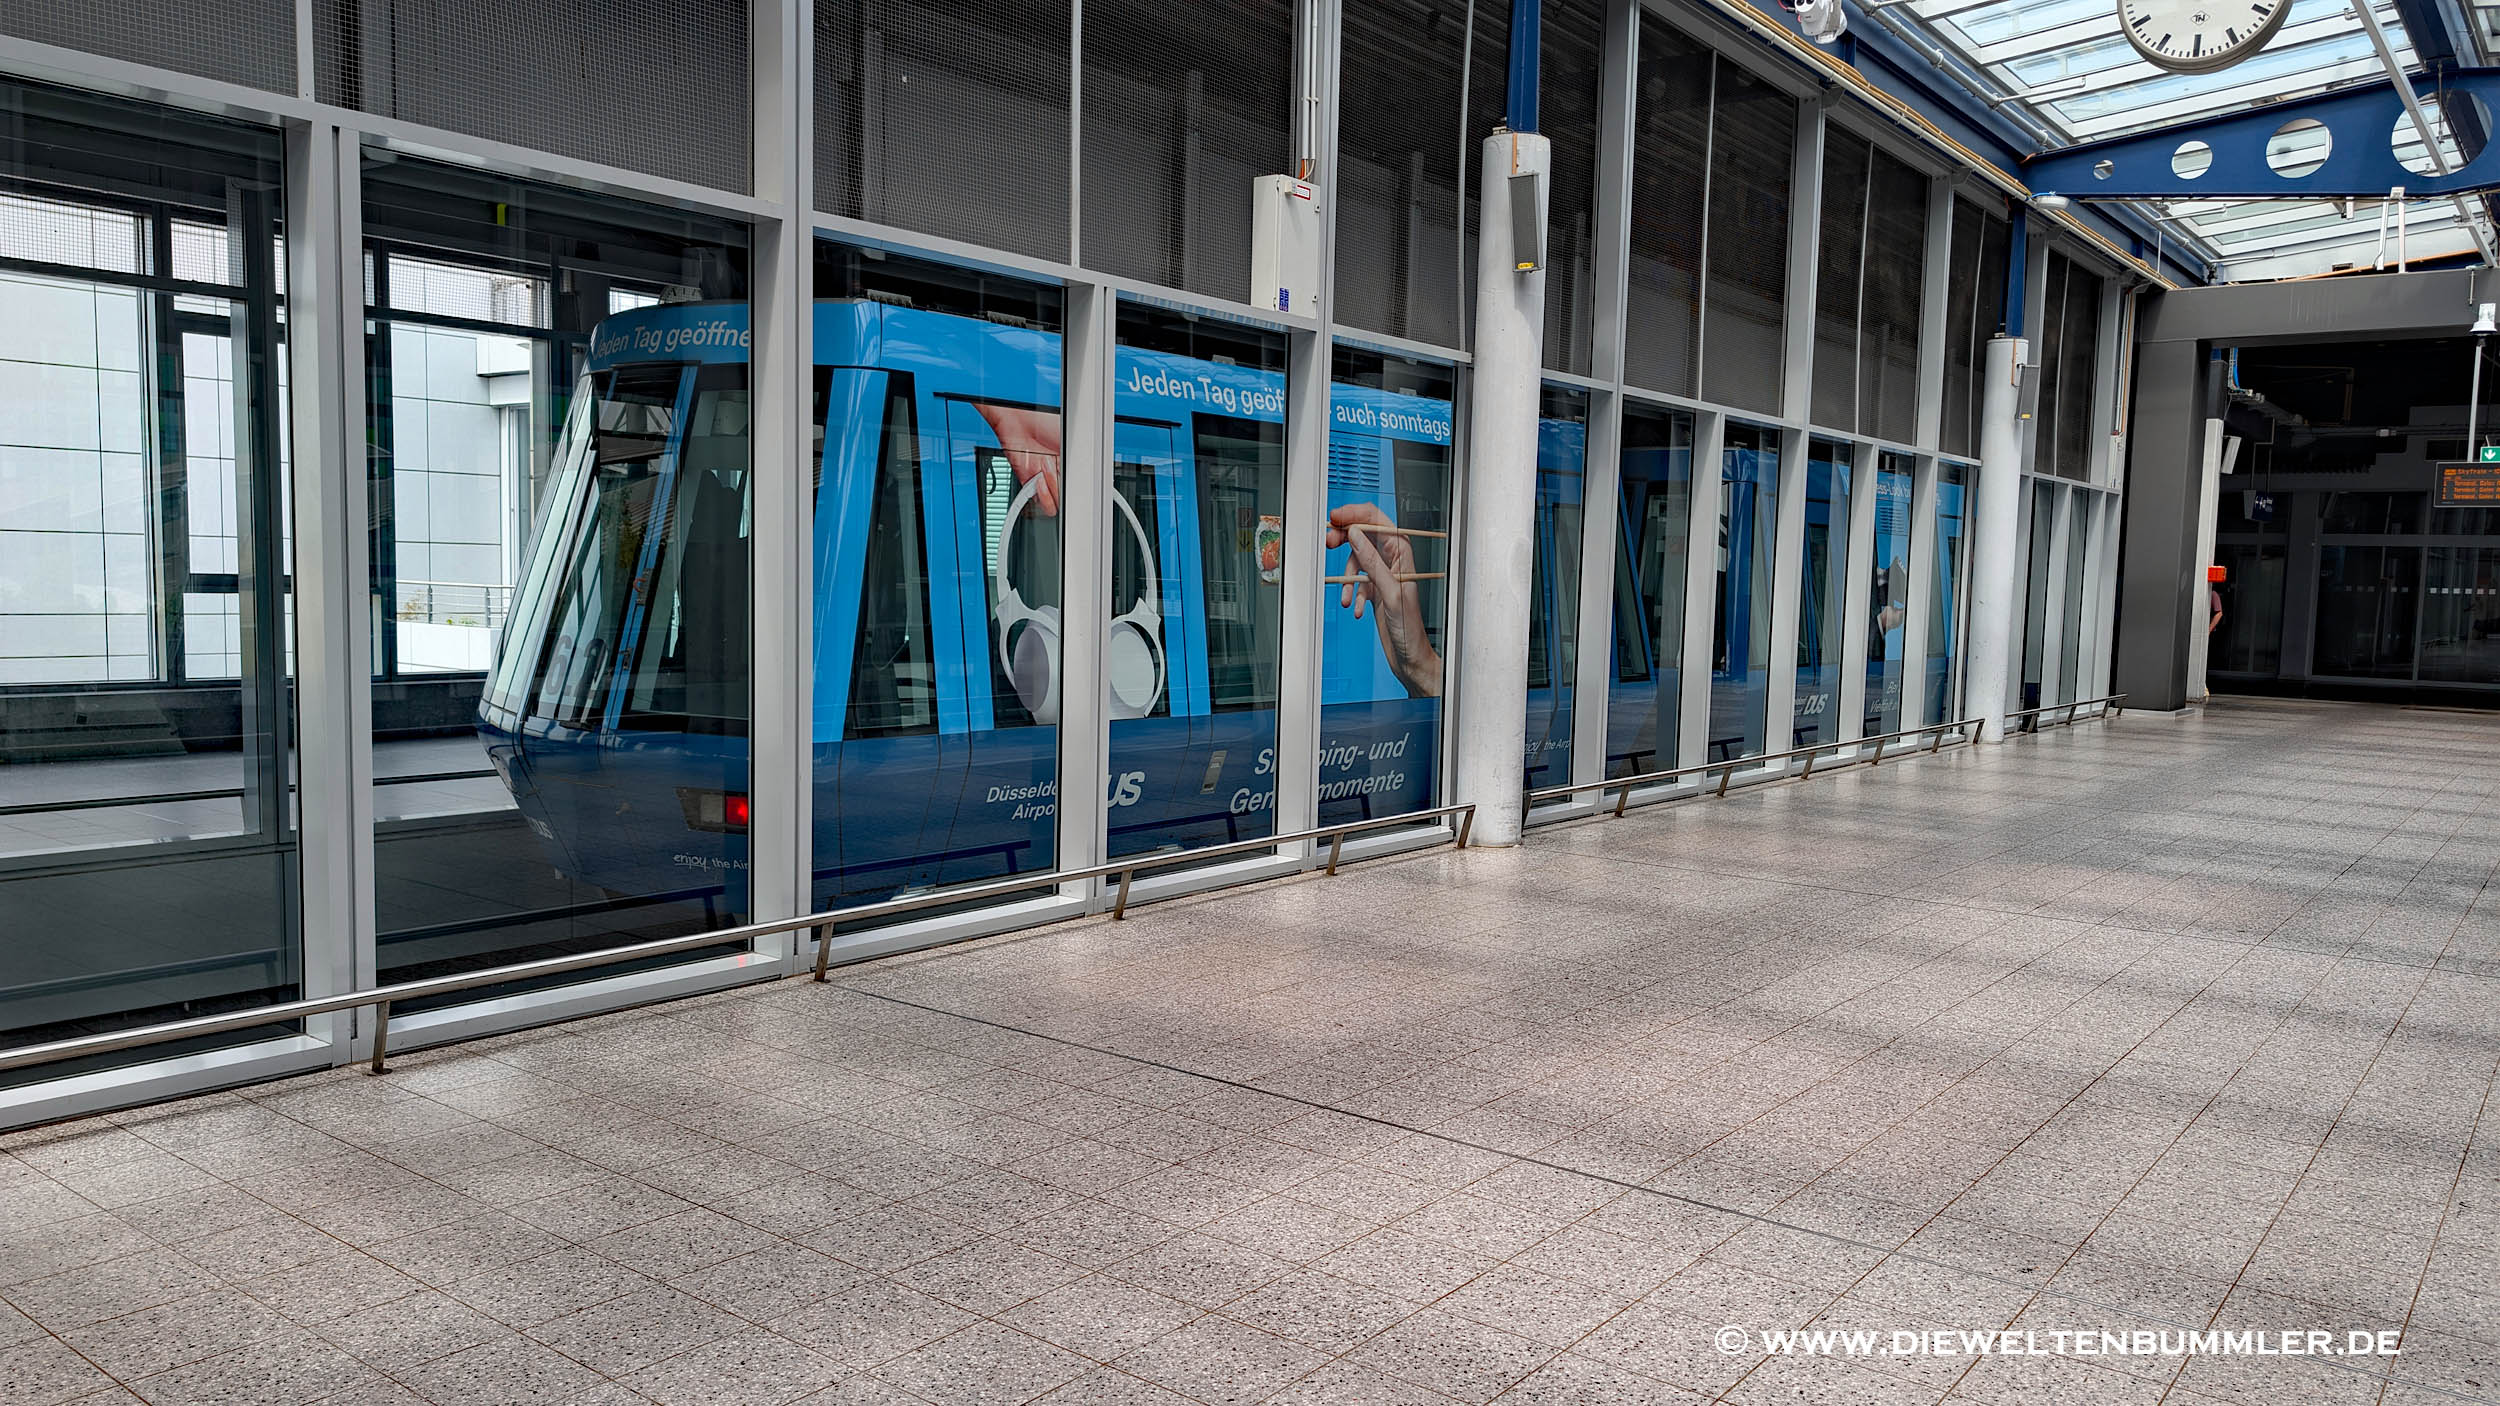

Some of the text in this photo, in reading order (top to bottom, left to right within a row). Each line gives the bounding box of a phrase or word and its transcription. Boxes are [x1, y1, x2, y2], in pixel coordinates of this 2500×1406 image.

[634, 326, 663, 354] Tag
[665, 321, 749, 353] geöffne
[1128, 366, 1451, 441] Jeden Tag geöf auch sonntags
[1368, 732, 1410, 761] und
[986, 780, 1057, 803] Düsseld
[1107, 771, 1146, 808] US
[1011, 802, 1056, 821] Airpo
[673, 852, 711, 873] enjoy
[712, 857, 731, 869] the
